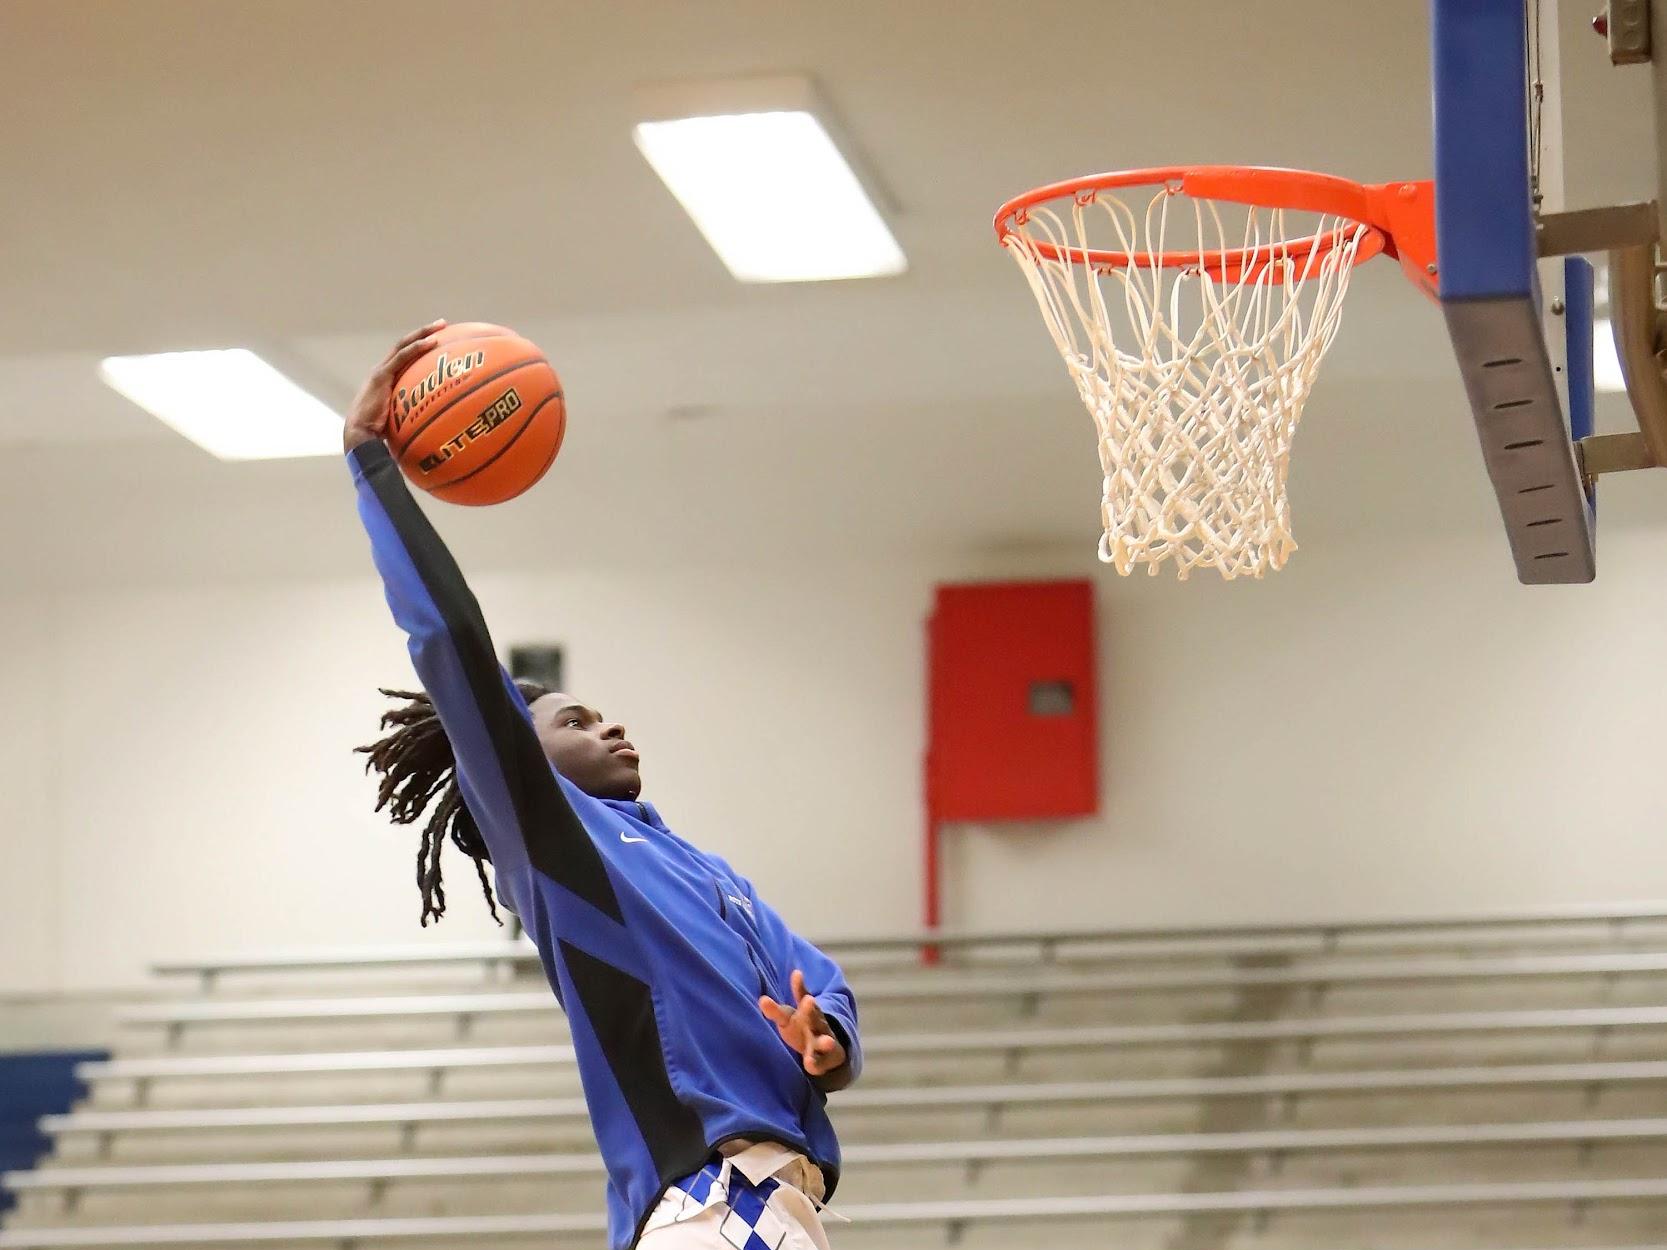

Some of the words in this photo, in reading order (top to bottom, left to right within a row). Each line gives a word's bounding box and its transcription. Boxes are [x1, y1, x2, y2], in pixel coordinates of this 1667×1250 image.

[391, 351, 484, 433] Baden
[419, 415, 489, 474] ELITE
[484, 388, 522, 432] PRO
